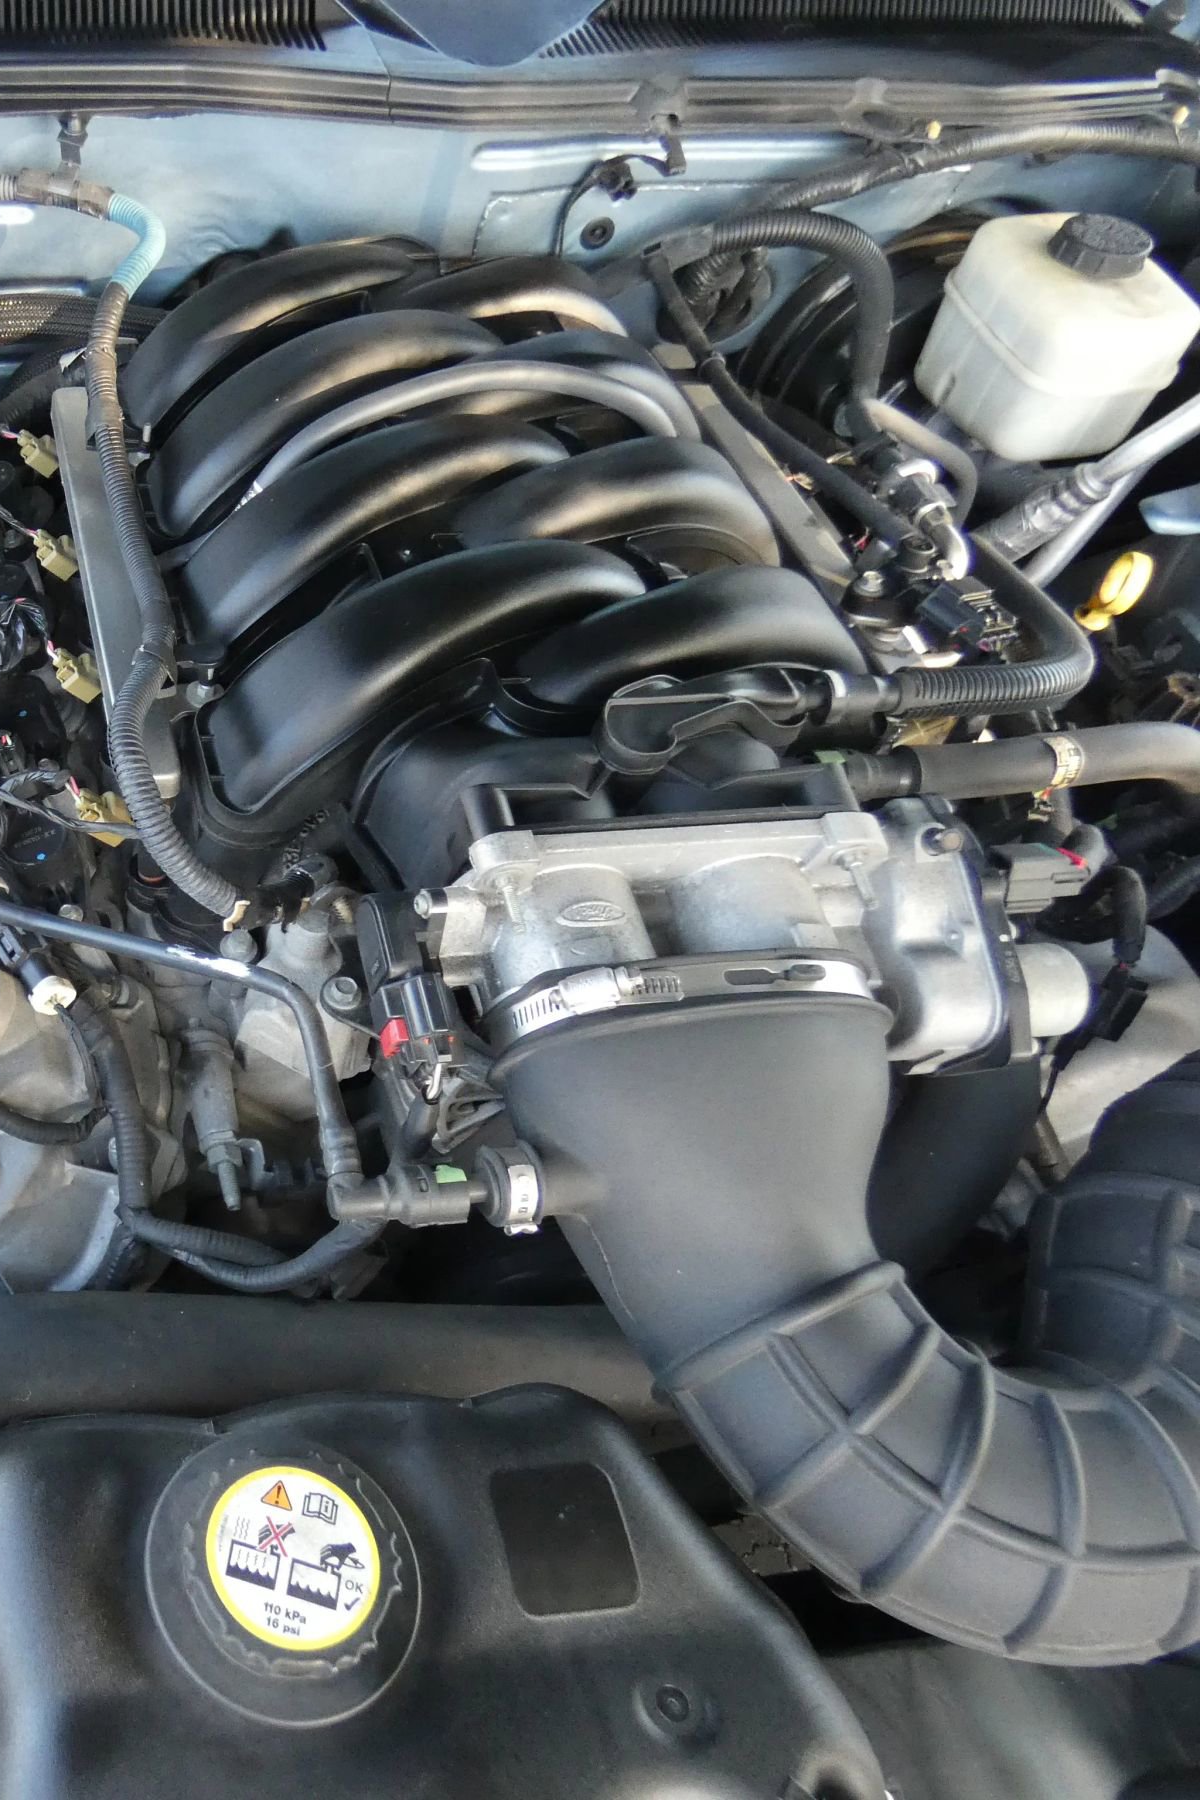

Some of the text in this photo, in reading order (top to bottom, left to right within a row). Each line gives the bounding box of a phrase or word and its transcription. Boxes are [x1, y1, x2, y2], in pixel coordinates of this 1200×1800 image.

[344, 1579, 364, 1594] OK
[263, 1601, 307, 1625] 110 kPa
[266, 1616, 301, 1636] 16 psi
